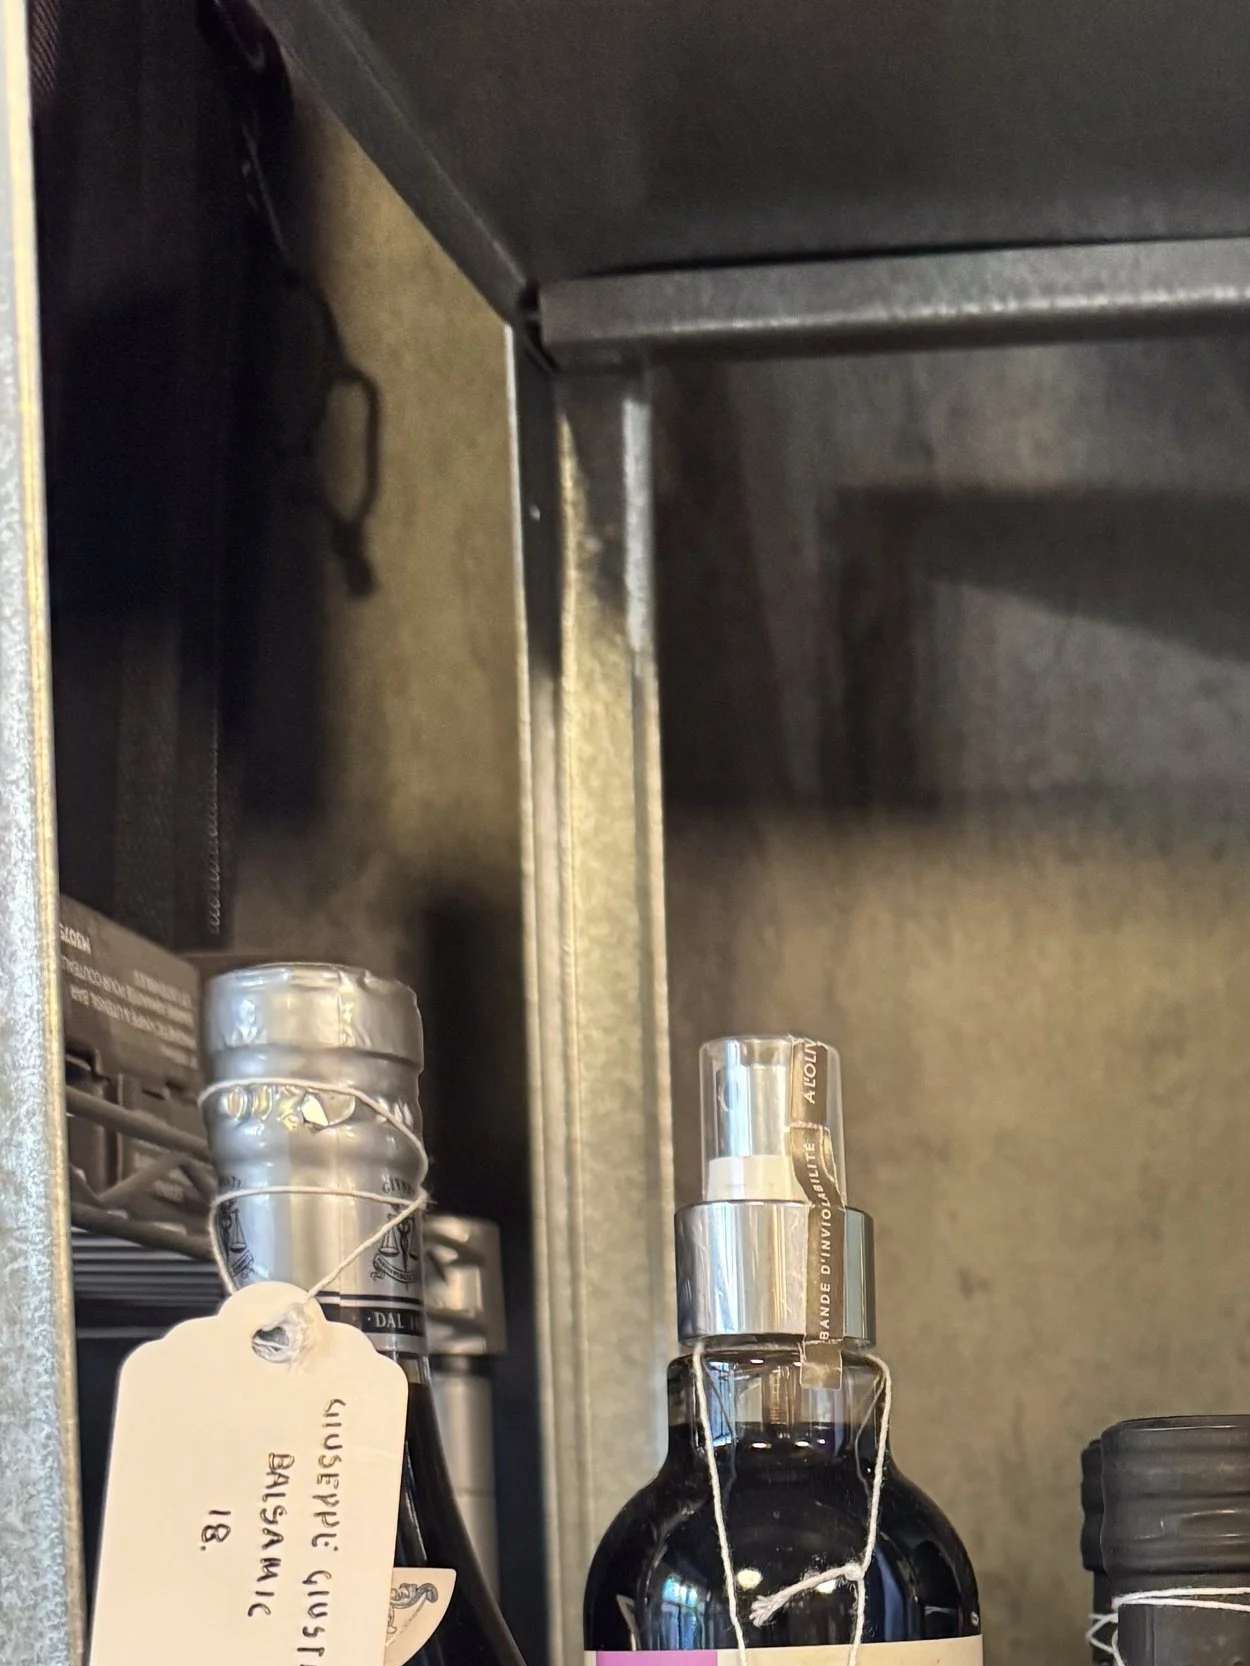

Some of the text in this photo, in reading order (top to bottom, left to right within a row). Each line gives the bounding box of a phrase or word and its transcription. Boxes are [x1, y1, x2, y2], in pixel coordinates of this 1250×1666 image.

[374, 1311, 405, 1328] DAL
[820, 1282, 832, 1340] BANDE
[311, 1399, 346, 1551] GIUSEPPE
[200, 1509, 231, 1551] 18.
[247, 1453, 295, 1618] BALSAMIC
